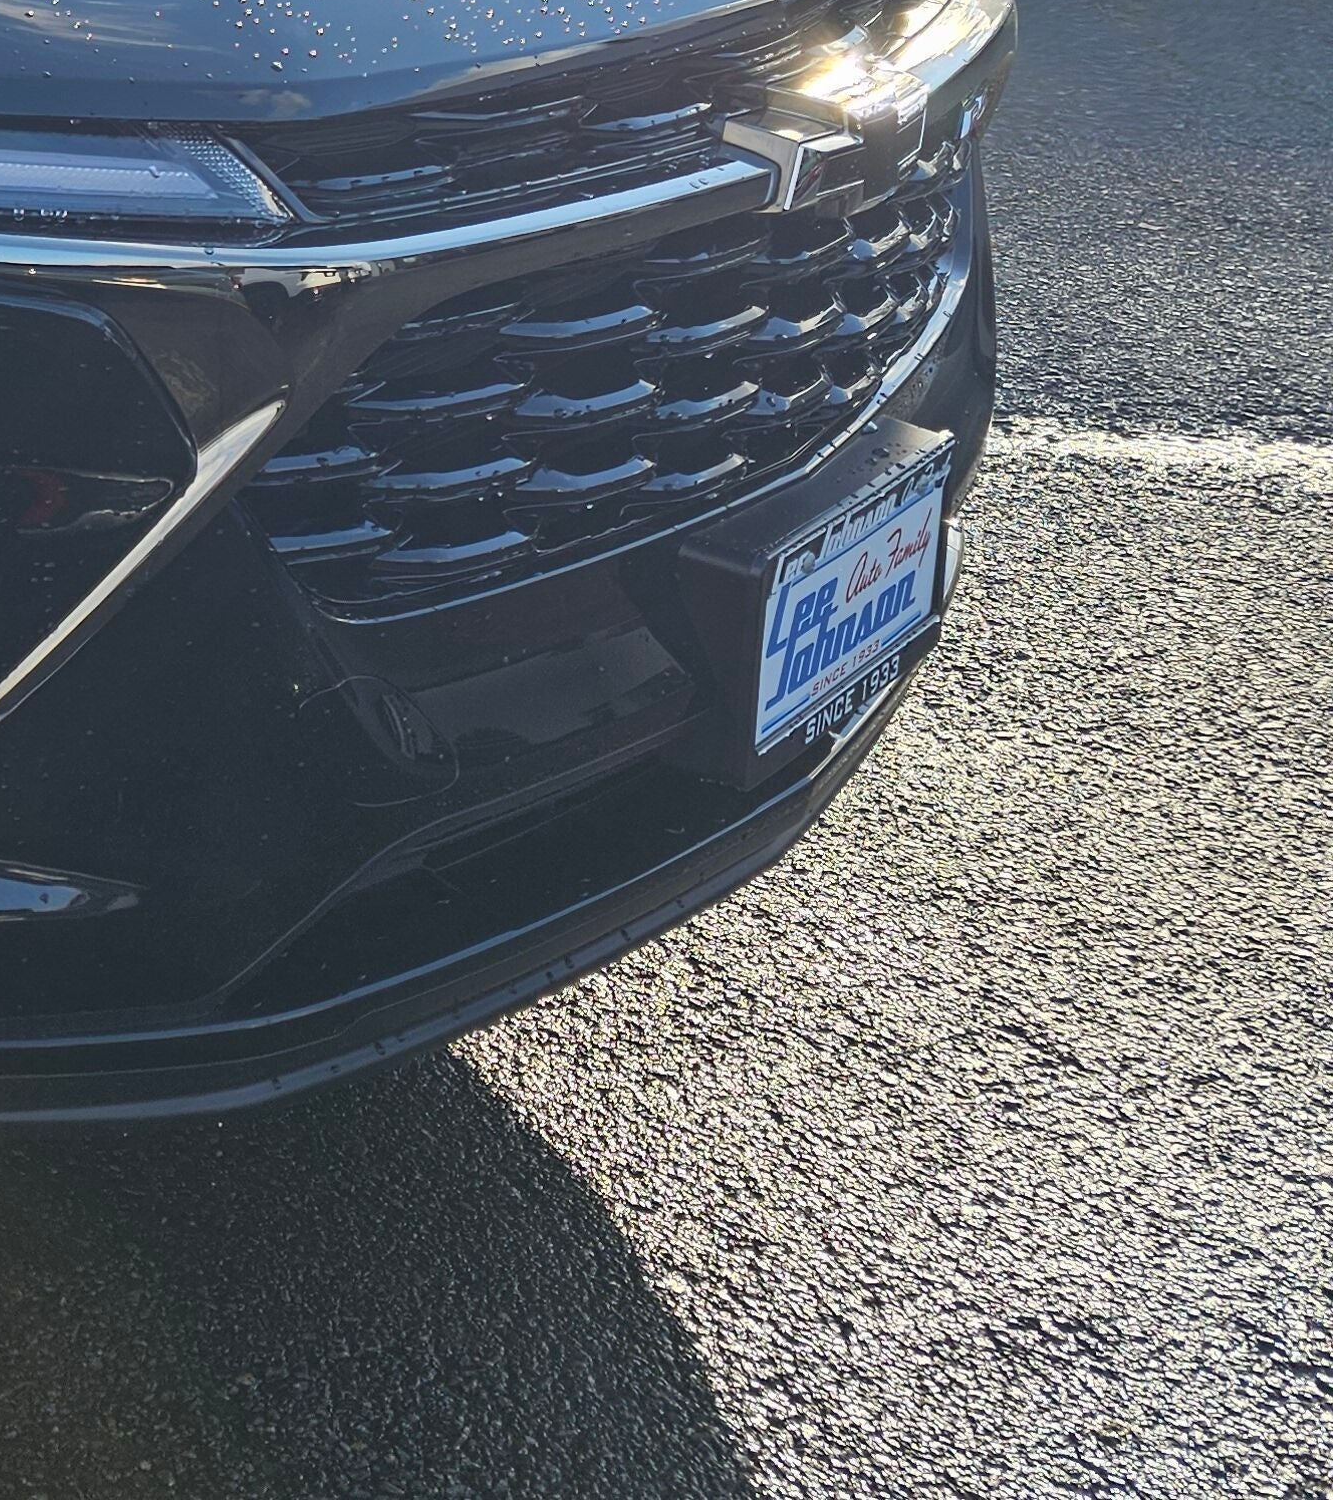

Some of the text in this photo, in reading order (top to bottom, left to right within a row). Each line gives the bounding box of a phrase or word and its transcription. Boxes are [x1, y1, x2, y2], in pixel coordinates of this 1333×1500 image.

[815, 493, 898, 568] Johnson
[766, 507, 932, 659] Lee Auto Family
[765, 570, 916, 711] Johnson
[811, 639, 880, 696] SINCE 1933
[805, 655, 900, 745] SINCE 1933
